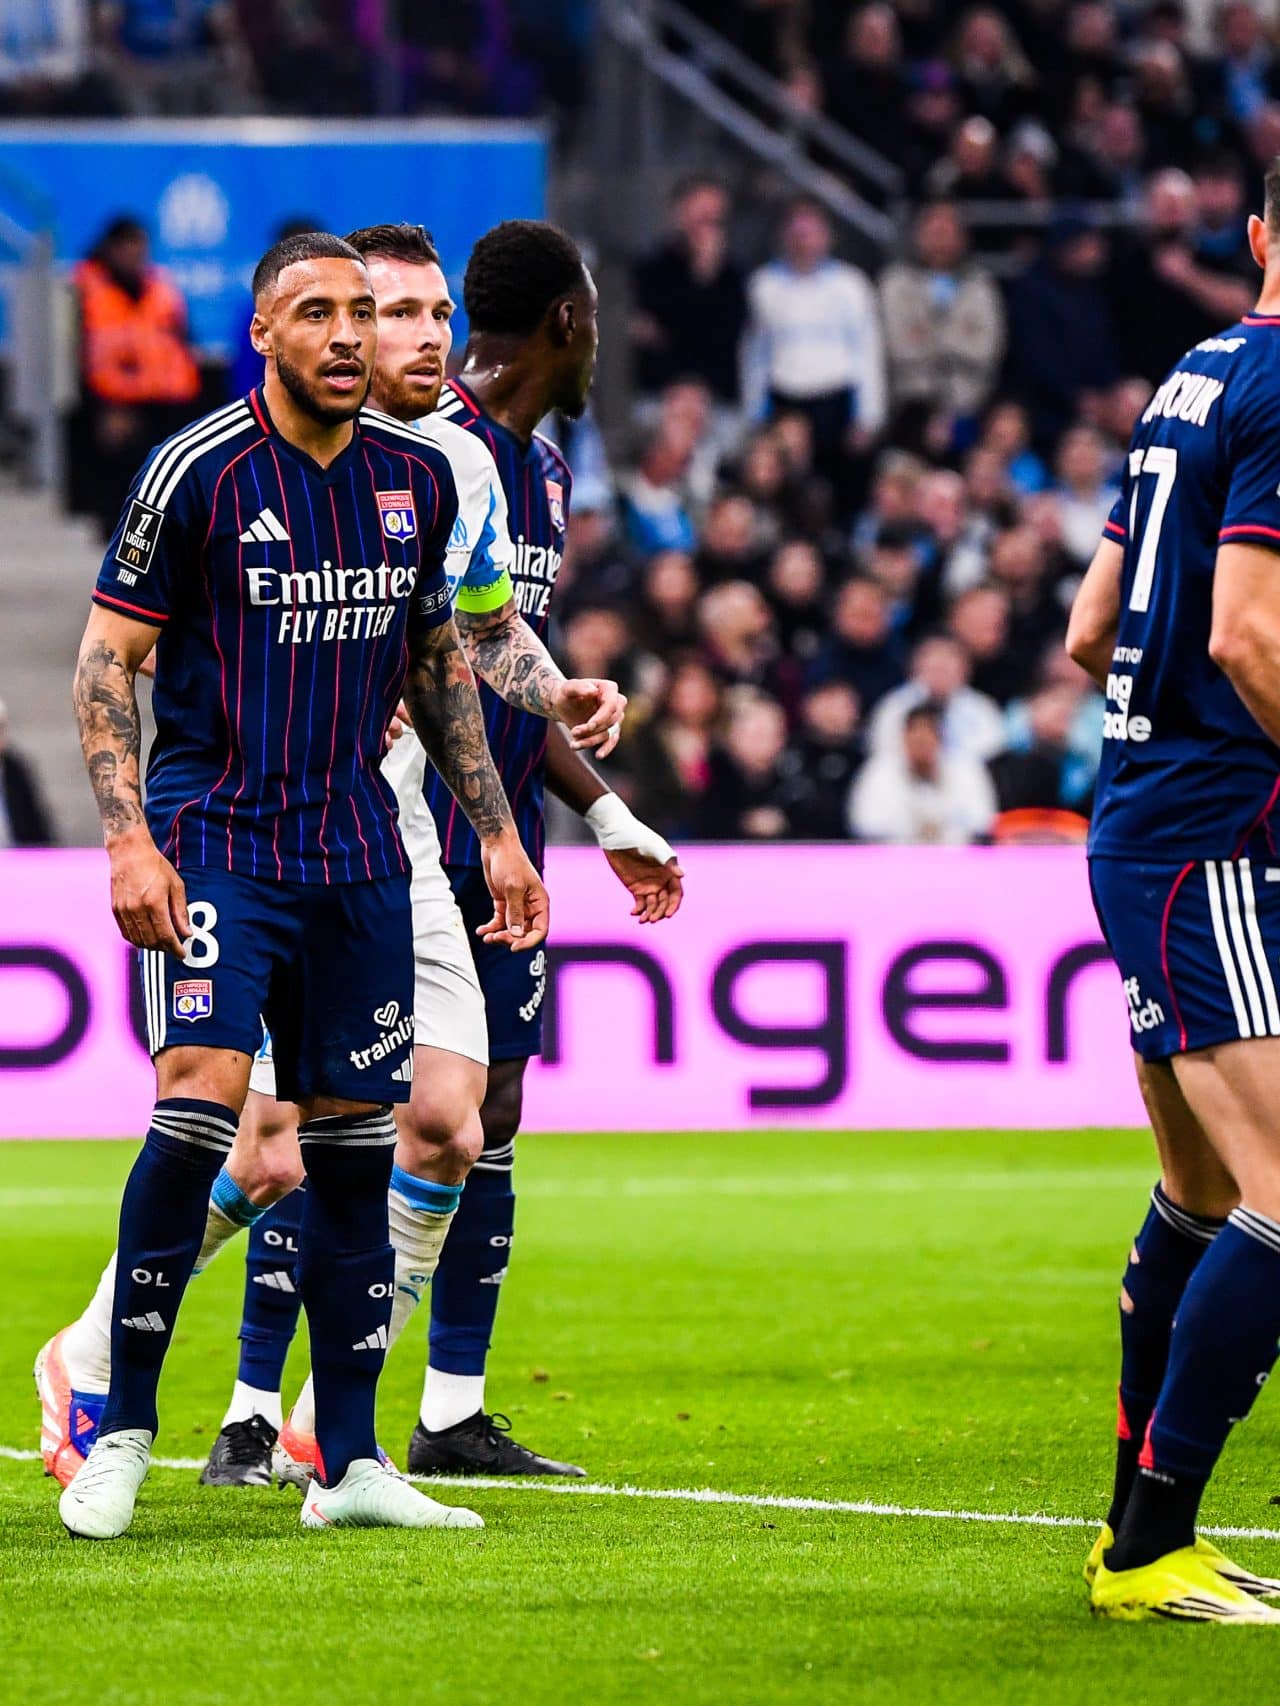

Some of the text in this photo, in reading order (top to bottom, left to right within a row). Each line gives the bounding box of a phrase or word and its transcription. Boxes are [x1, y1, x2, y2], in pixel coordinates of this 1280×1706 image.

[385, 511, 413, 533] OL
[245, 560, 417, 606] Emirates
[278, 604, 395, 644] FLY BETTER
[182, 901, 219, 968] 8
[177, 996, 209, 1014] OL
[263, 1230, 298, 1252] OL
[131, 1268, 170, 1288] OL
[368, 1282, 394, 1299] OL
